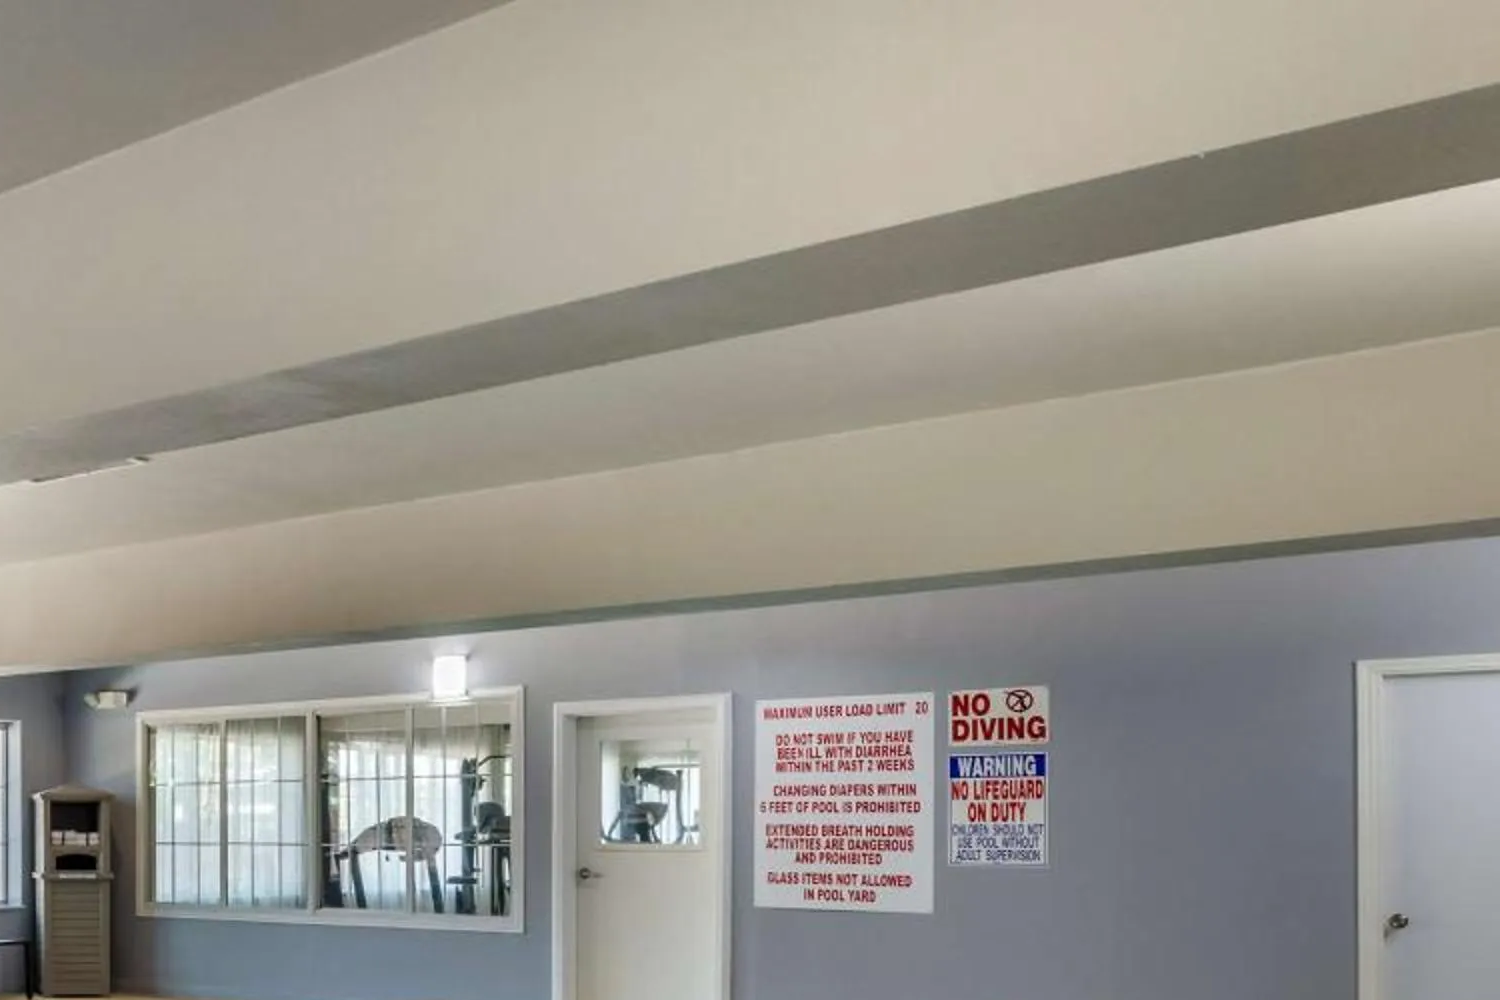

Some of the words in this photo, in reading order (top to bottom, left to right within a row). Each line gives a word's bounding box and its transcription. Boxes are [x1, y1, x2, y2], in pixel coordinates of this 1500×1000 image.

[764, 706, 812, 719] MAXIMUM
[816, 705, 843, 717] USER
[845, 703, 873, 716] LOAD
[876, 702, 906, 715] LIMIT
[915, 701, 928, 715] 20
[952, 693, 991, 717] NO
[952, 716, 1046, 741] DIVING
[775, 734, 791, 746] DO
[793, 733, 813, 745] NOT
[817, 732, 845, 744] SWIM
[847, 732, 856, 744] IF
[860, 731, 881, 744] YOU
[885, 730, 914, 743] HAVE
[777, 748, 803, 760] BEEN
[805, 747, 821, 758] ILL
[825, 746, 852, 758] WITH
[855, 745, 912, 758] DIARRHEA
[775, 761, 812, 772] WITHIN
[815, 760, 834, 772] THE
[838, 759, 864, 772] PAST
[867, 759, 873, 772] 2
[876, 758, 915, 771] WEEKS
[957, 755, 1037, 777] WARNING
[773, 784, 827, 797] CHANGING
[830, 784, 874, 796] DIAPERS
[877, 783, 916, 796] WITHIN
[951, 781, 969, 800] NO
[974, 780, 1044, 800] LIFEGUARD
[769, 801, 793, 813] FEET
[796, 801, 808, 813] OF
[811, 801, 839, 813] POOL
[843, 801, 852, 813] IS
[856, 801, 921, 813] PROHIBITED
[968, 803, 986, 822] ON
[991, 802, 1027, 822] DUTY
[766, 824, 818, 836] EXTENDED
[821, 825, 862, 837] BREATH
[865, 825, 914, 837] HOLDING
[951, 824, 989, 837] CHILDREN
[993, 823, 1025, 836] SHOULD
[1027, 823, 1044, 835] NOT
[766, 838, 821, 850] ACTIVITIES
[824, 838, 845, 850] ARE
[848, 839, 914, 852] DANGEROUS
[957, 837, 972, 848] USE
[976, 837, 999, 848] POOL
[1001, 836, 1040, 848] WITHOUT
[795, 852, 816, 864] AND
[819, 852, 882, 865] PROHIBITED
[956, 849, 981, 861] ADULT
[986, 849, 1041, 861] SUPERVISION
[767, 872, 799, 884] GLASS
[801, 873, 832, 885] ITEMS
[836, 874, 858, 886] NOT
[861, 875, 912, 888] ALLOWED
[803, 889, 815, 901] IN
[818, 889, 845, 902] POOL
[849, 890, 877, 903] YARD
